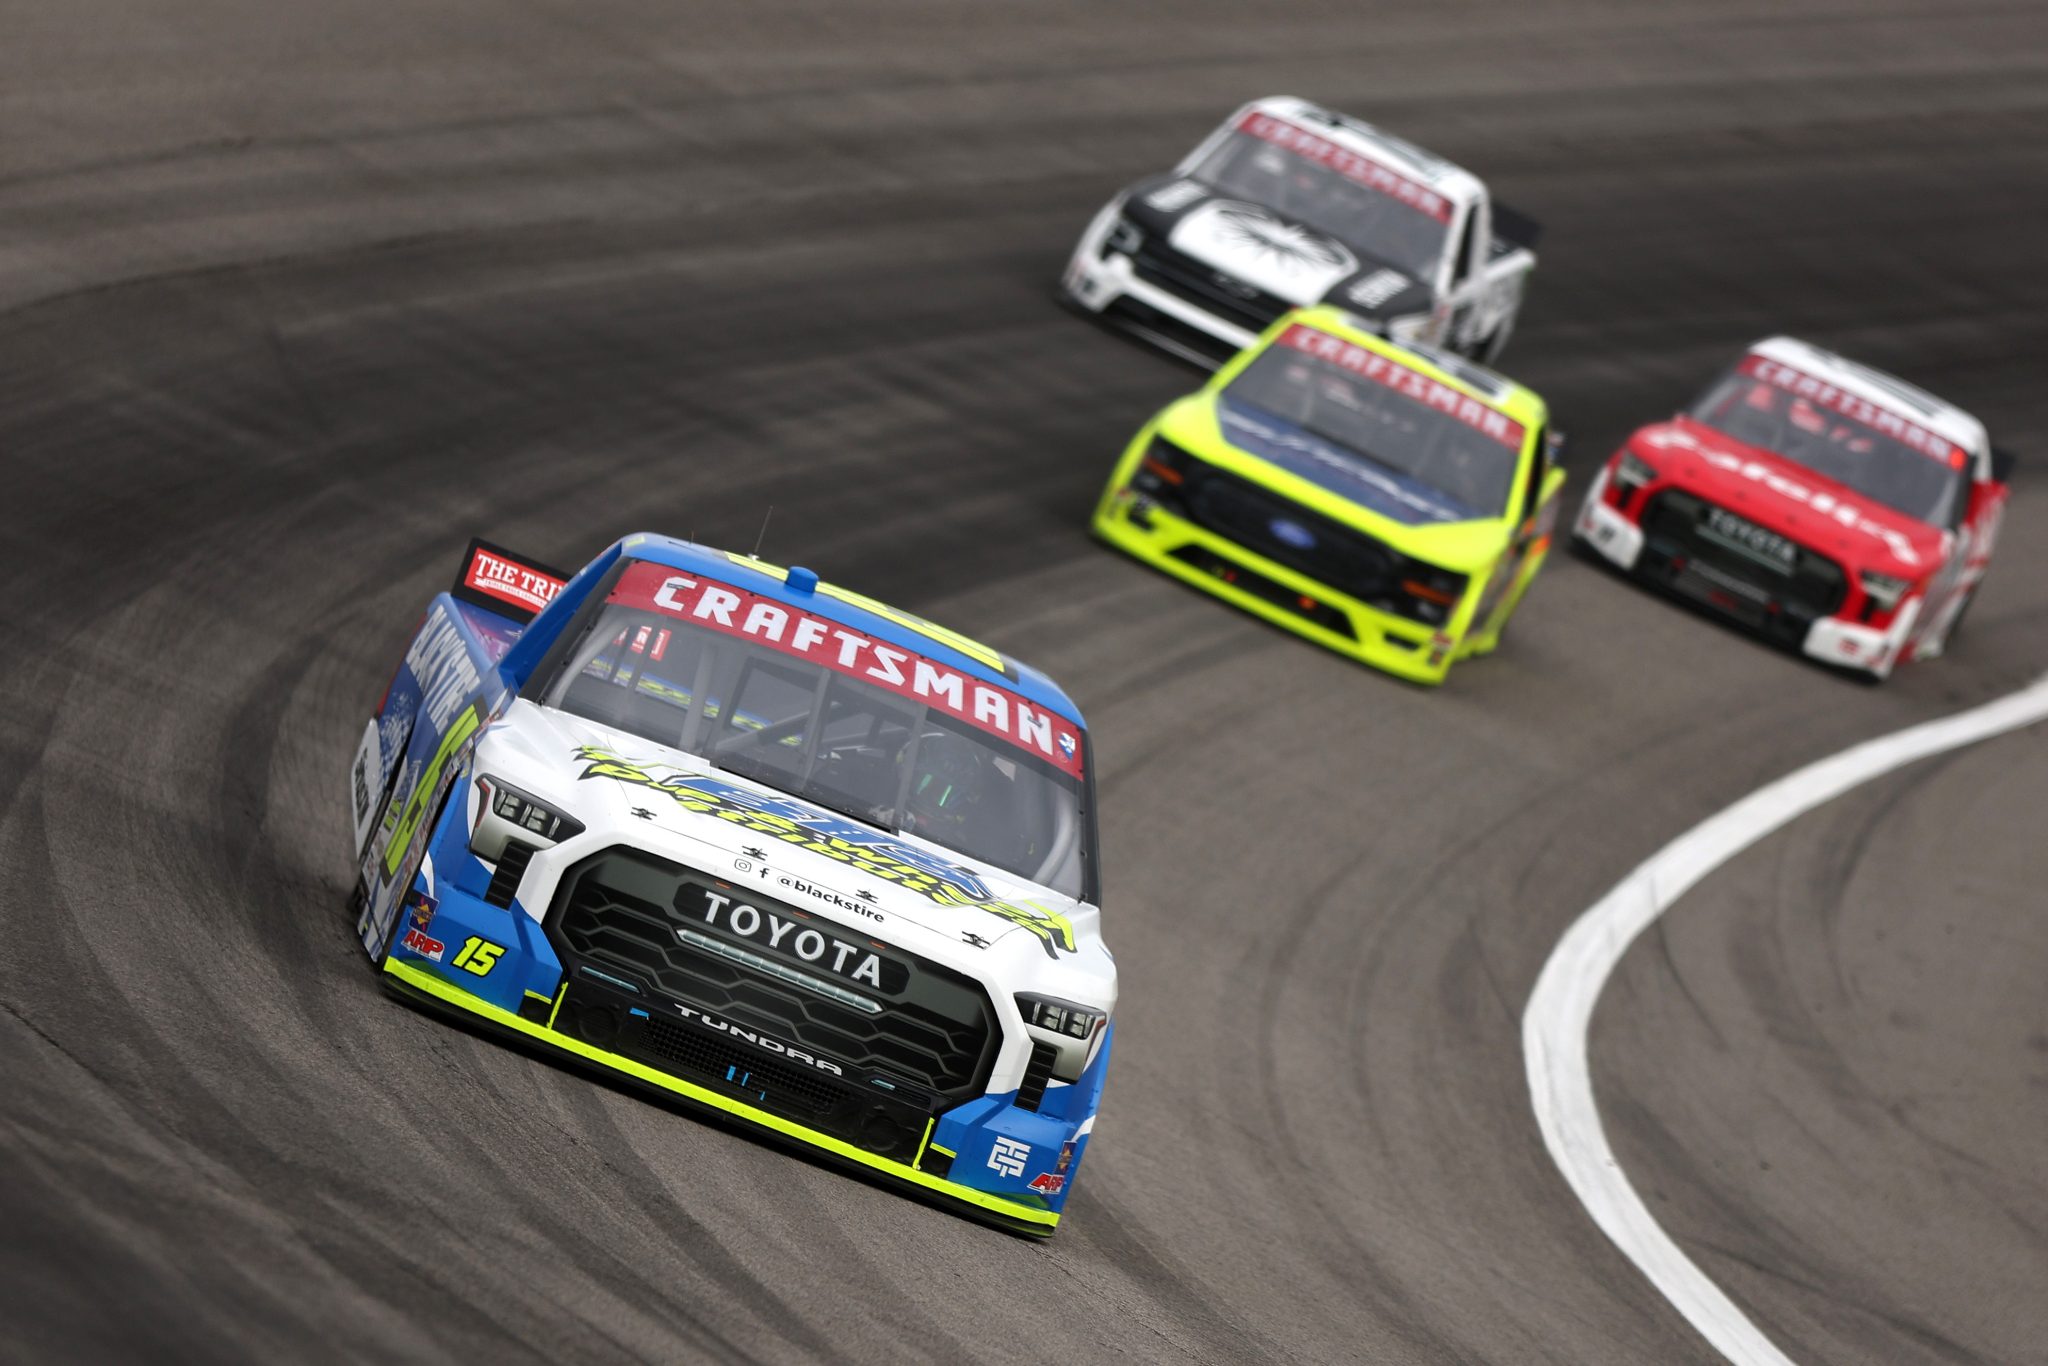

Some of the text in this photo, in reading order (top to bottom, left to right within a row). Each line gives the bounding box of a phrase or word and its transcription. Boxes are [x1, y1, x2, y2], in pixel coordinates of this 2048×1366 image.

[1294, 326, 1509, 436] CRAFTSMAN
[476, 553, 519, 585] THE
[520, 570, 564, 601] TRI
[653, 575, 1054, 755] CRAFTSMAN
[776, 874, 886, 924] @blackstire
[403, 929, 445, 956] ARP
[452, 936, 506, 977] 15
[704, 890, 881, 990] TOYOTA
[673, 1002, 843, 1077] TUNDRA
